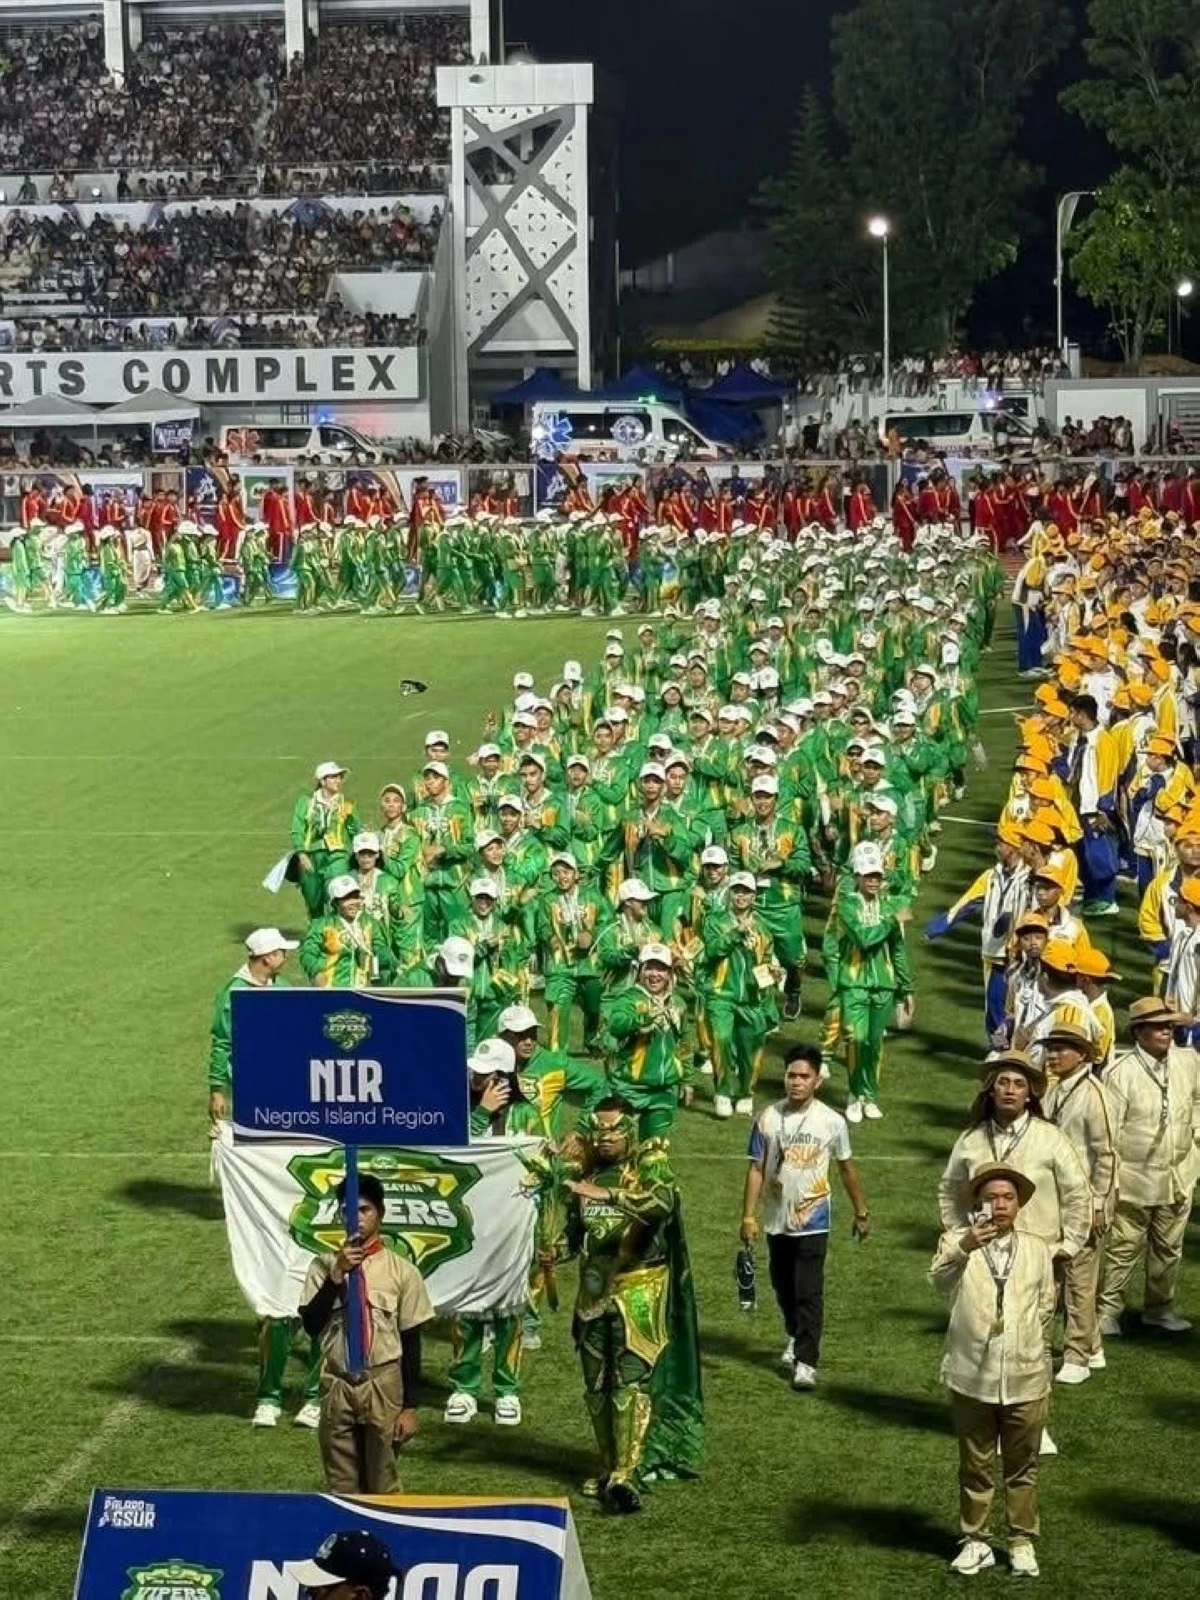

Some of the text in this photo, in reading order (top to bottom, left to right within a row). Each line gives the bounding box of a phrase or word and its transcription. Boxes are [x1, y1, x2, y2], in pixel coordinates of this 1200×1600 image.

[123, 355, 397, 394] COMPLEX
[310, 1060, 383, 1102] NIR
[254, 1107, 445, 1129] Negros Island Region
[311, 1198, 458, 1228] VERS
